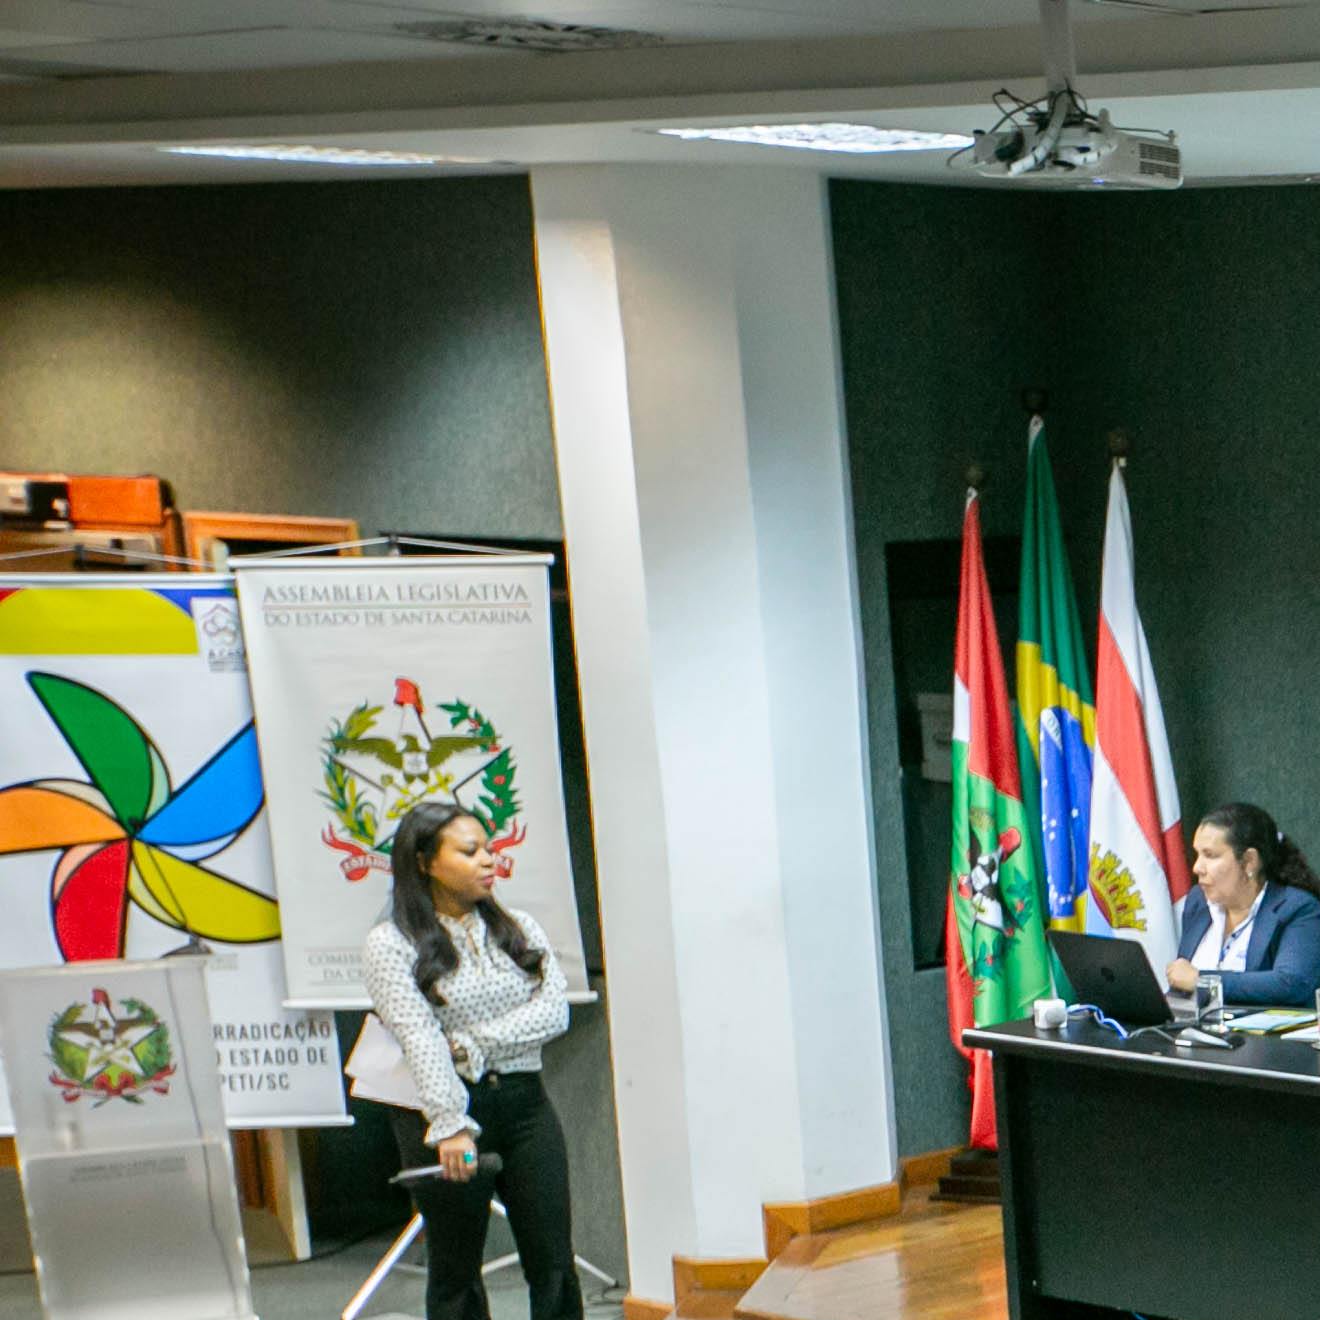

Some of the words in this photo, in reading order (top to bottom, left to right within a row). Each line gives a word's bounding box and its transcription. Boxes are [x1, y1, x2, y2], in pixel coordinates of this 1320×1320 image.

[262, 584, 390, 602] ASSEMBLEIA
[396, 583, 529, 602] LEGISLATIVA
[263, 612, 290, 628] DO
[295, 611, 360, 627] ESTADO
[364, 611, 385, 627] DE
[390, 611, 444, 625] SANTA
[447, 610, 532, 624] CATARINA
[230, 1046, 299, 1066] ESTADO
[307, 1046, 329, 1065] DE
